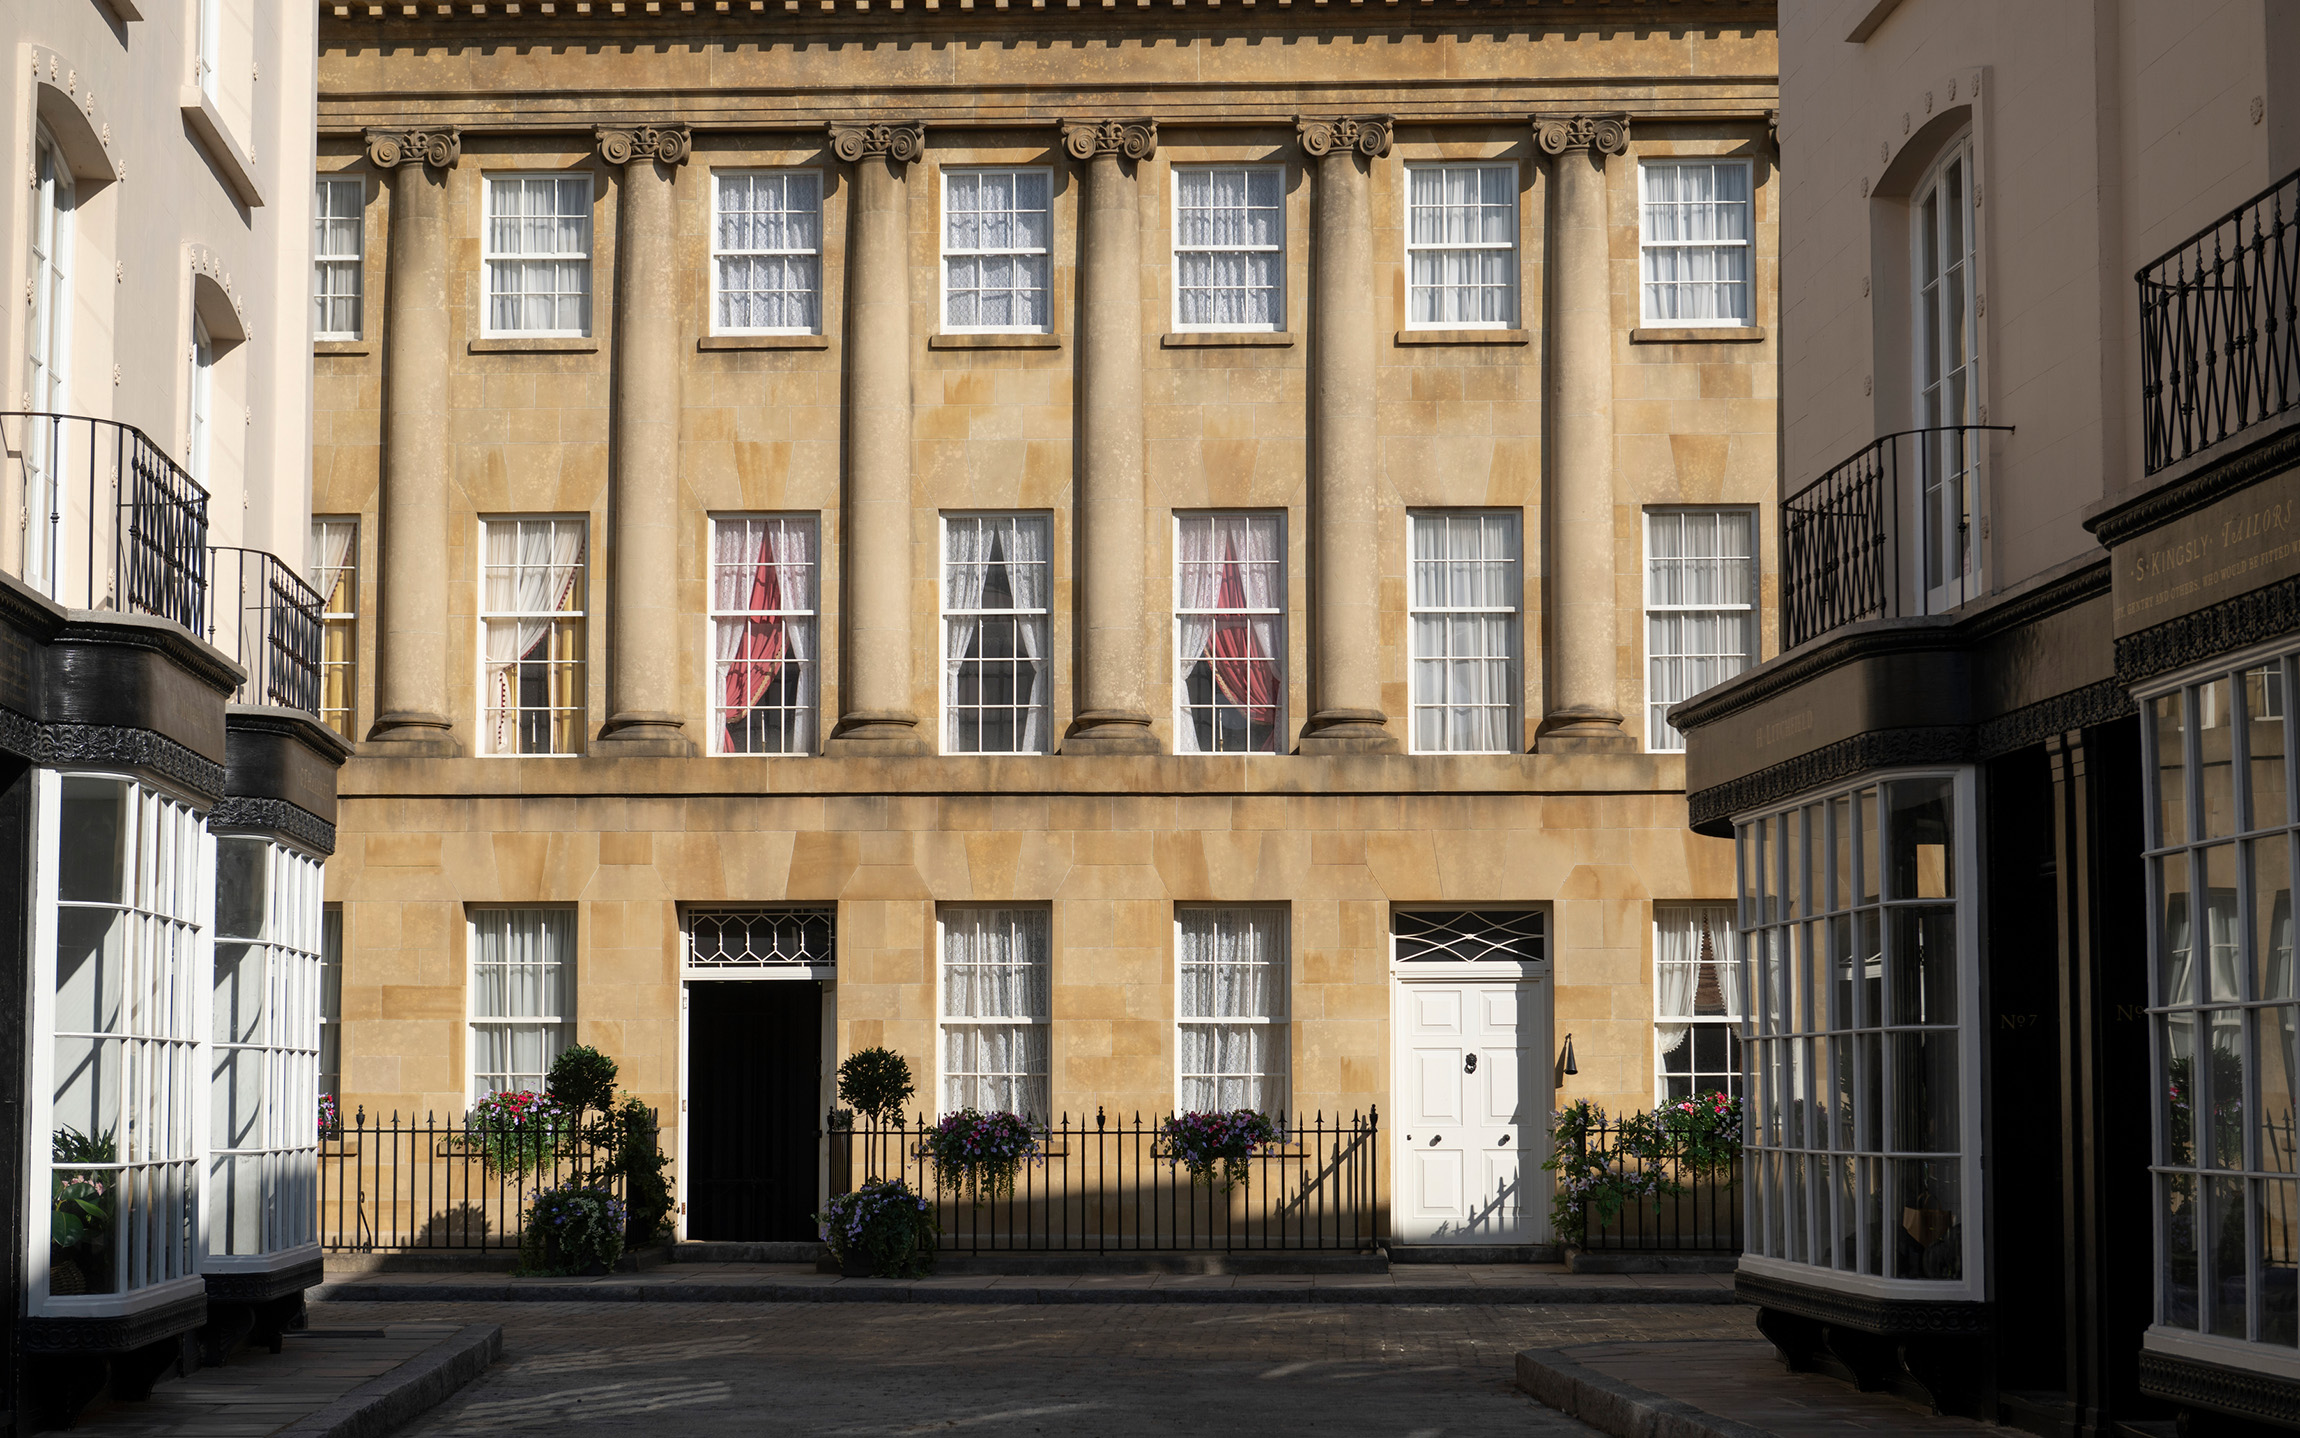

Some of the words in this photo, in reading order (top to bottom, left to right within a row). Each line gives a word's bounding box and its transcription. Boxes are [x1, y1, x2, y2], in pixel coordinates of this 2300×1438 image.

[2222, 499, 2293, 547] TAILORS
[2127, 596, 2153, 615] GENTRY
[2155, 590, 2169, 606] AND
[2202, 571, 2218, 587] WHO
[2220, 560, 2247, 580] WOULD
[2249, 555, 2259, 570] BE
[2261, 544, 2290, 566] FITTED
